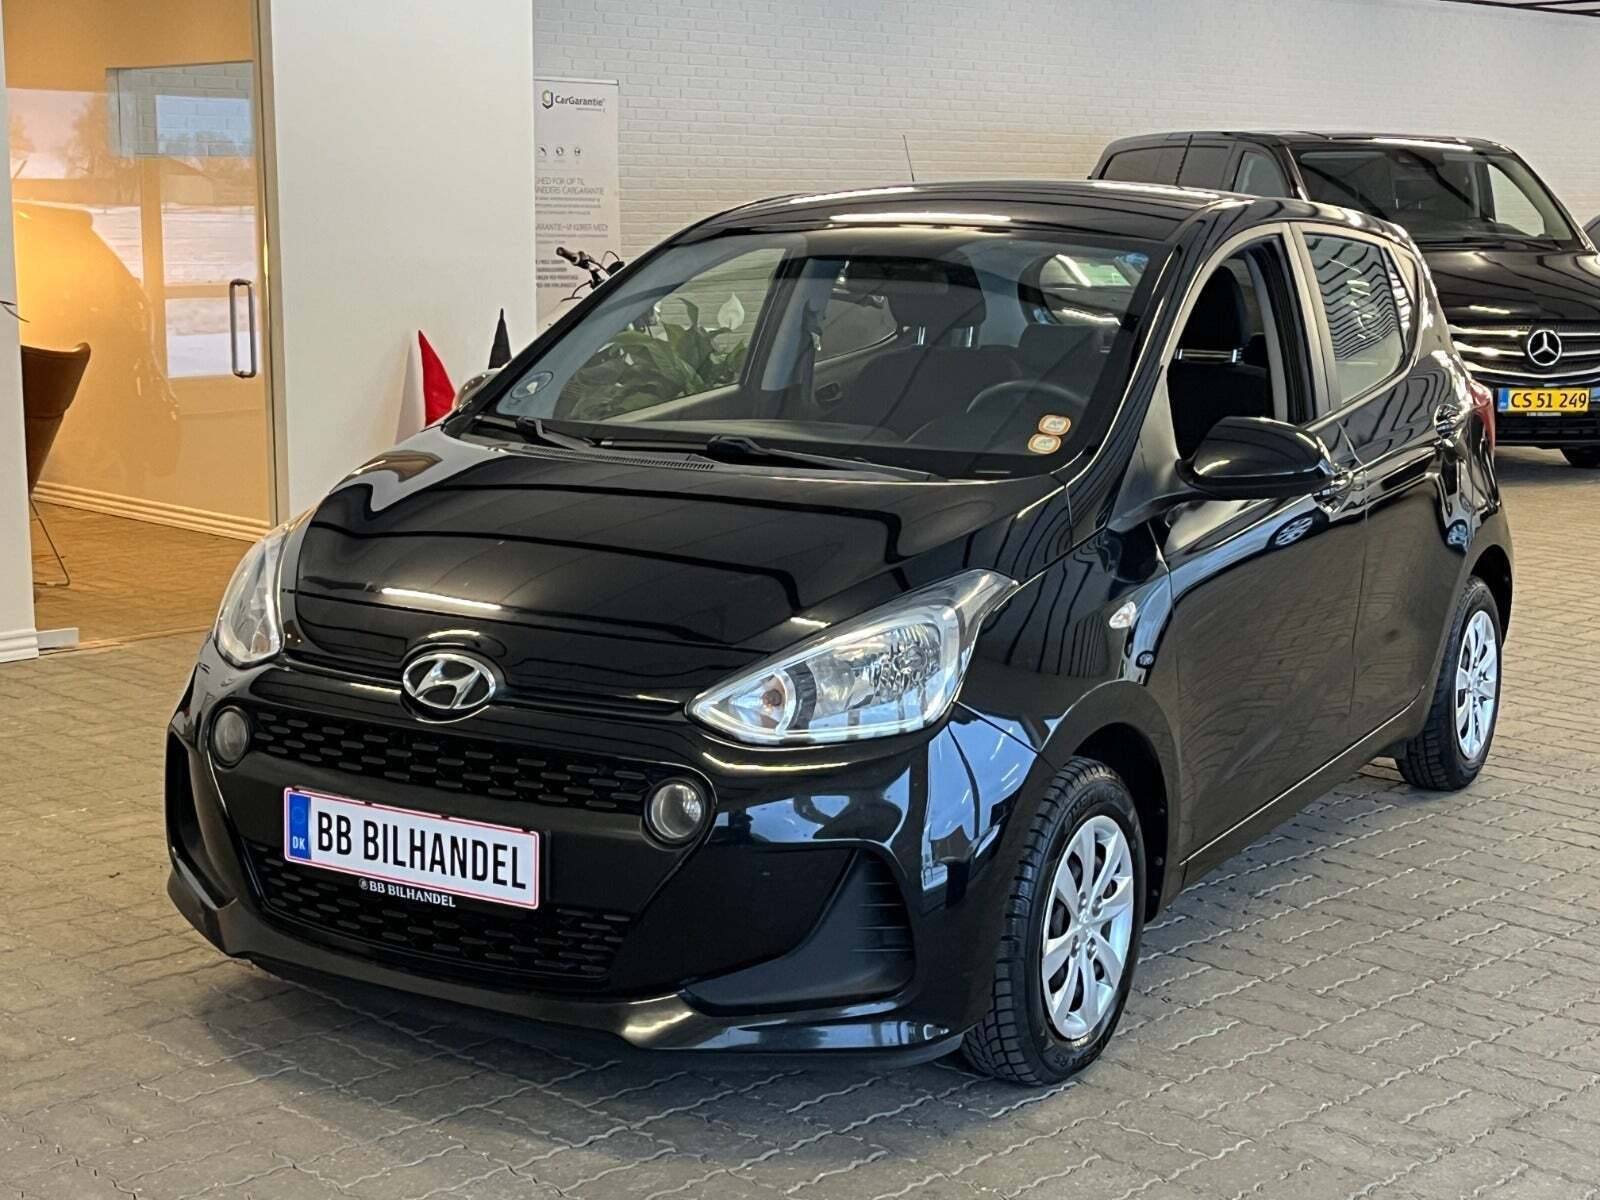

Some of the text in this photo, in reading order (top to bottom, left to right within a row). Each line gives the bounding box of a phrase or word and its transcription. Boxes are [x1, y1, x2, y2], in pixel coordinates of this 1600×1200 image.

[555, 95, 603, 106] CarGarantie
[1511, 393, 1587, 408] CS 51 249
[292, 836, 305, 850] DK
[317, 811, 527, 890] BB BILHANDEL
[369, 880, 456, 908] BB BILHANDEL
